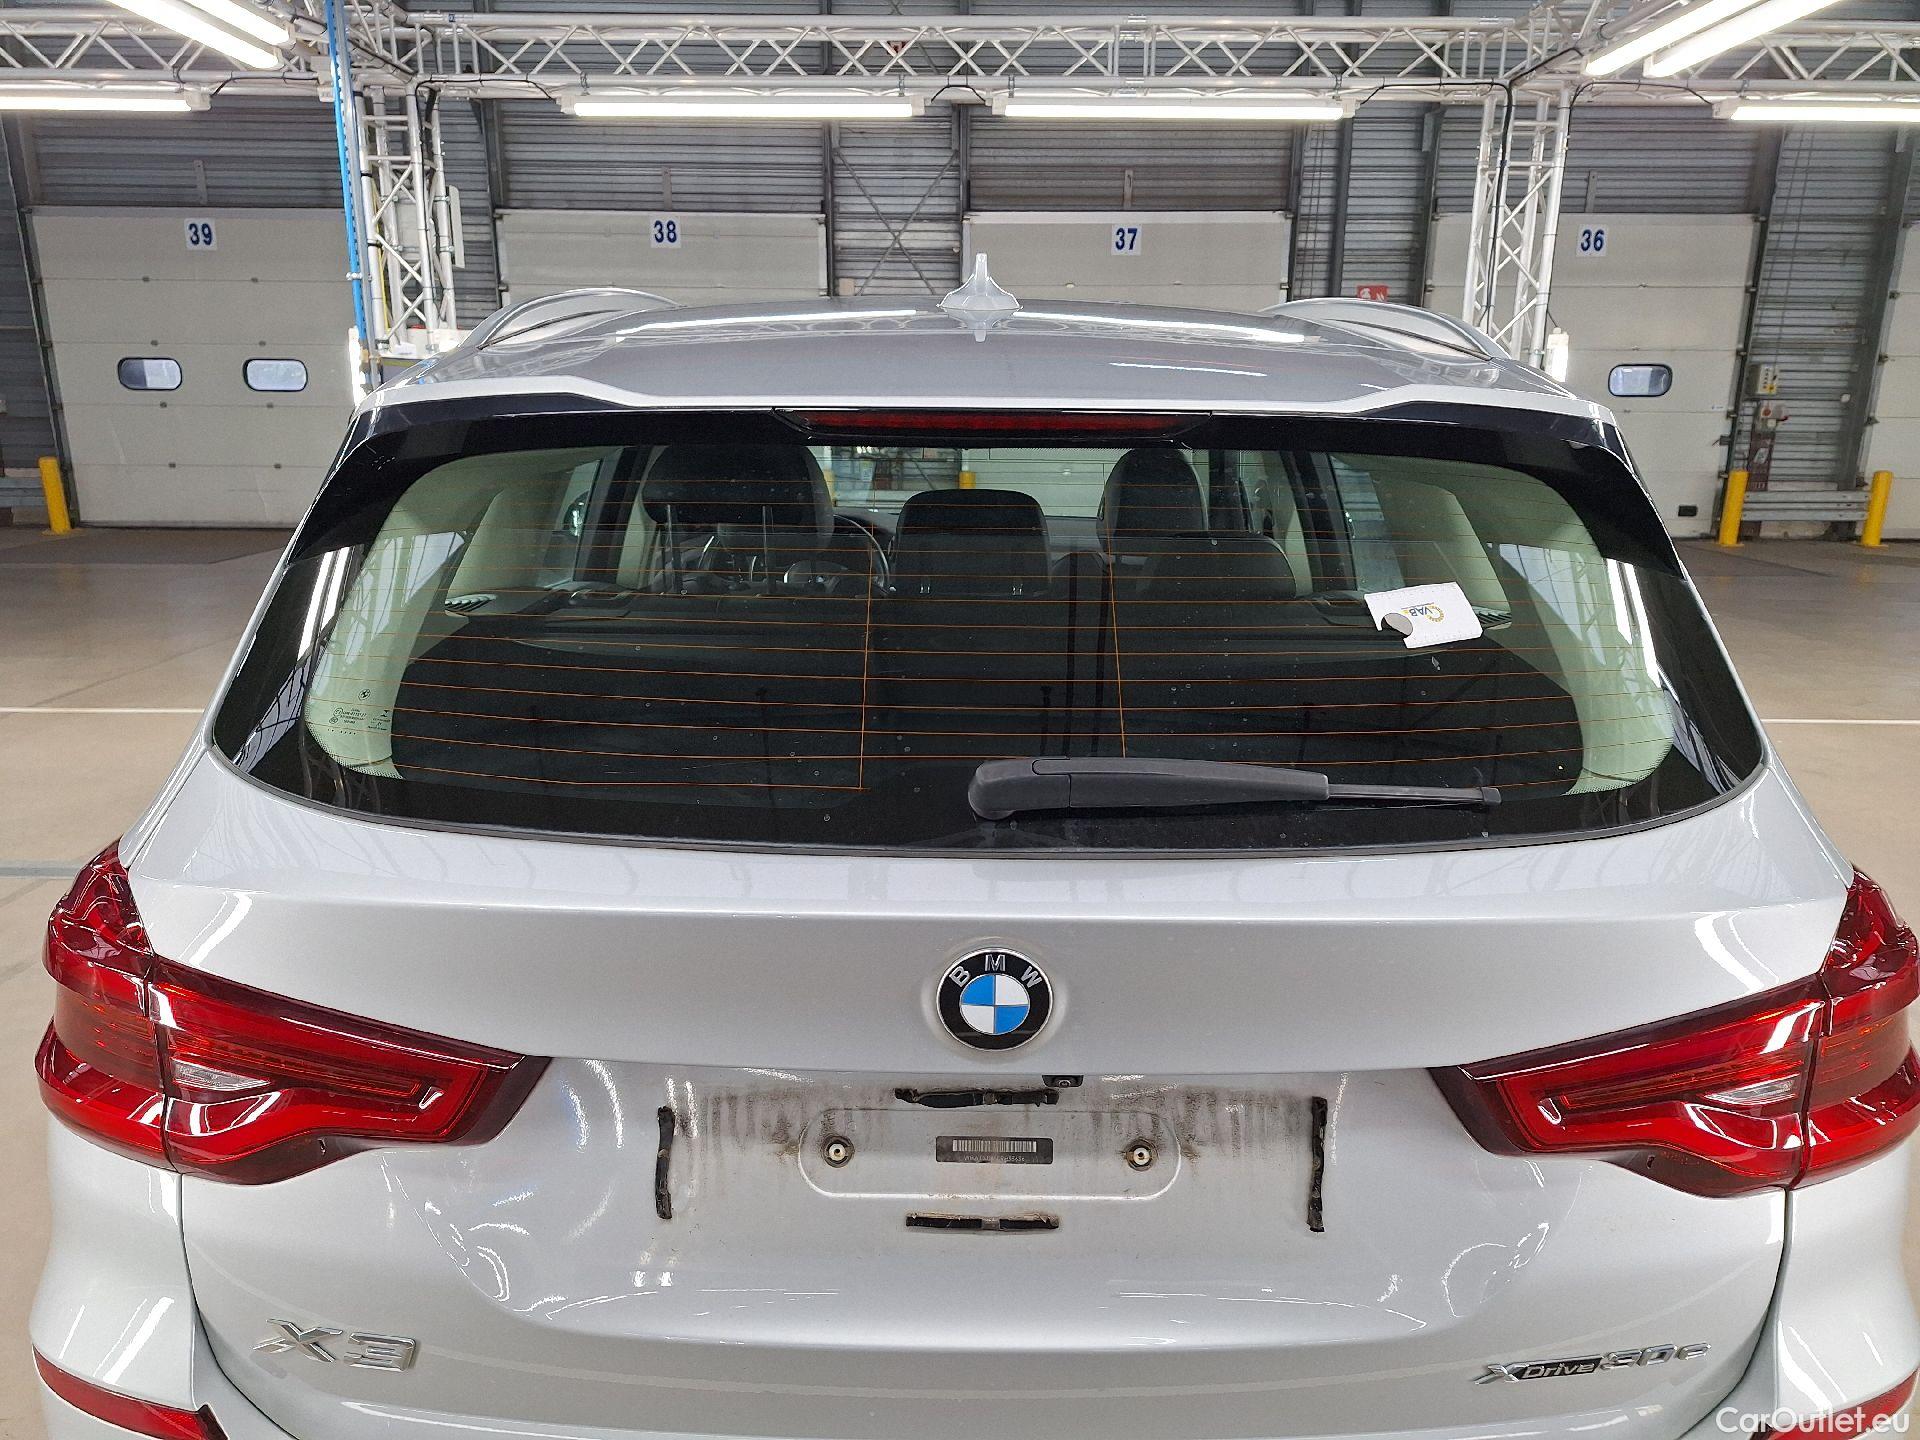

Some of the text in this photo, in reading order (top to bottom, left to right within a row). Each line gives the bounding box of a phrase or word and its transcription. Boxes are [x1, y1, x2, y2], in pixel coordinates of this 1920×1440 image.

[189, 223, 212, 245] 39
[654, 220, 677, 243] 38
[1115, 227, 1138, 250] 37
[1581, 229, 1604, 251] 36
[949, 954, 1043, 988] BMW
[252, 1318, 417, 1373] X3
